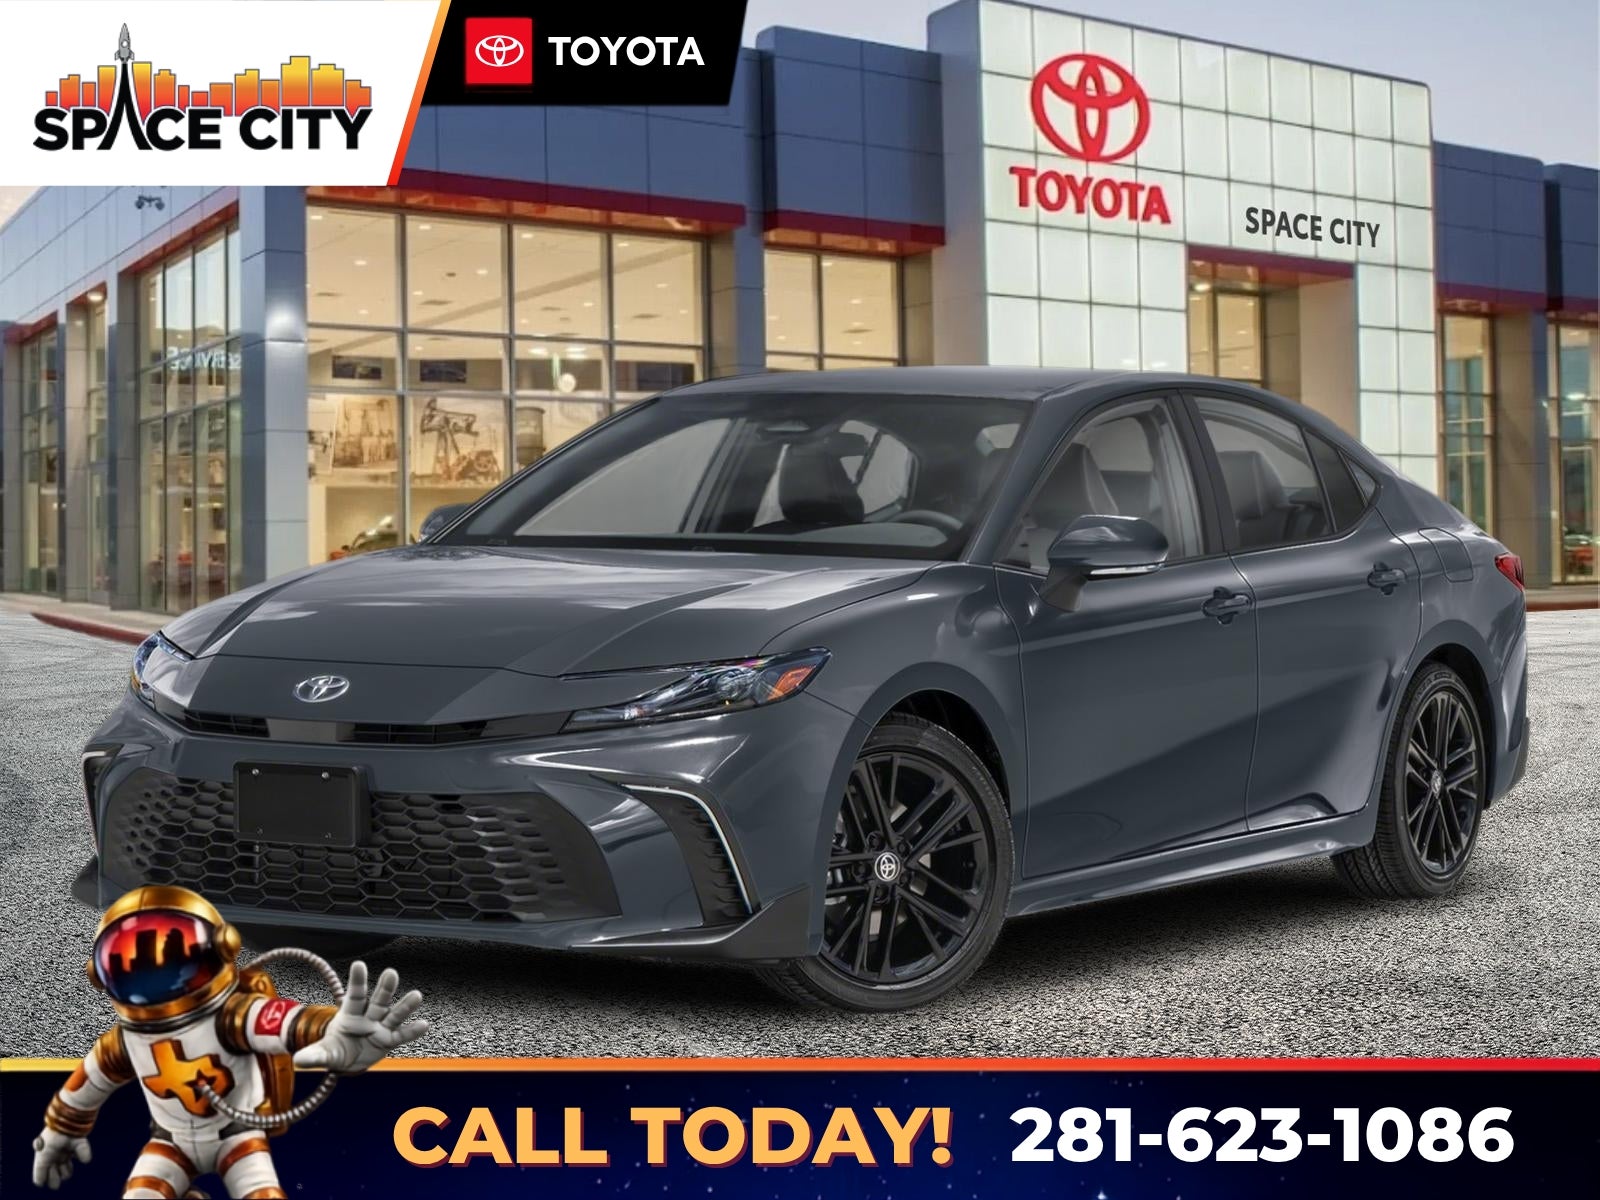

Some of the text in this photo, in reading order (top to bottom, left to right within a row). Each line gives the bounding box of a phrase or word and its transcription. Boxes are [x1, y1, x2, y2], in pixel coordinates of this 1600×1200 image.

[1009, 166, 1171, 224] TOYOTA
[1245, 206, 1380, 248] SPACE CITY
